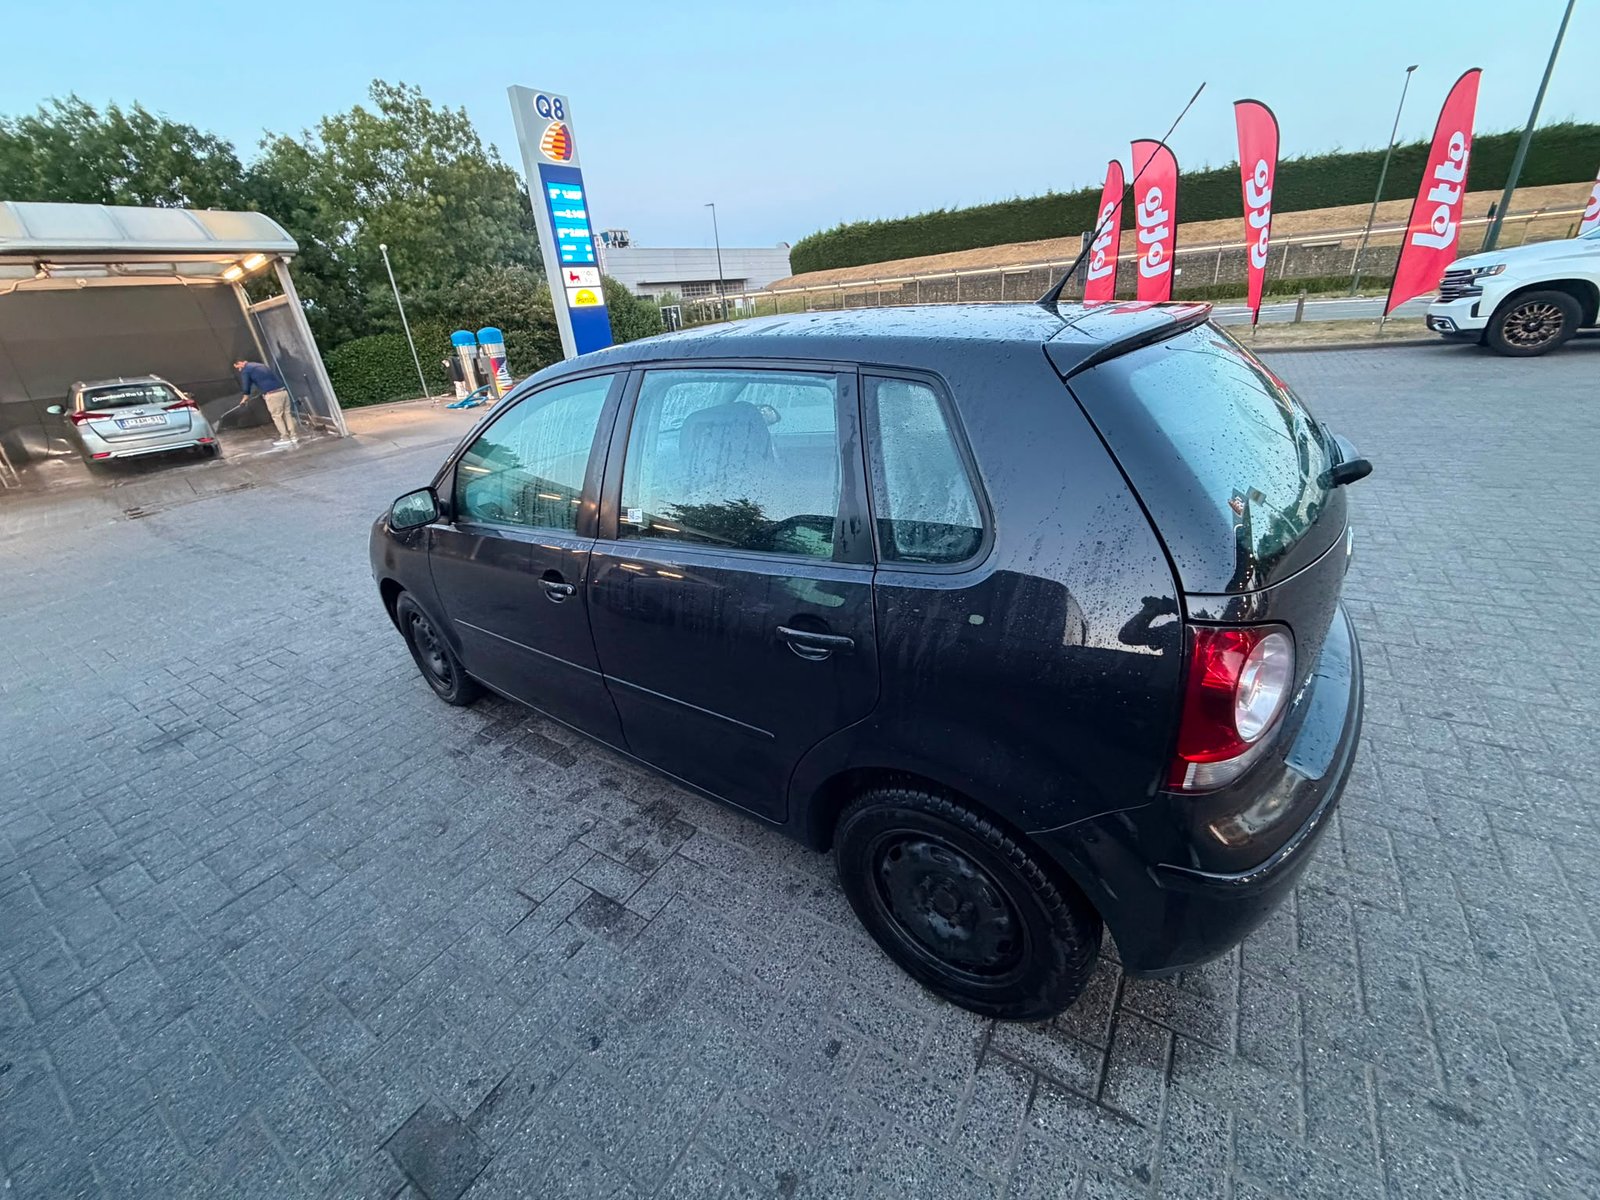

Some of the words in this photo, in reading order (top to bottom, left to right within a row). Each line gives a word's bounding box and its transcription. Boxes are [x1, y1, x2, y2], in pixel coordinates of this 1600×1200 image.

[535, 94, 565, 121] Q8
[1411, 131, 1469, 250] Lotto
[91, 393, 125, 403] Download
